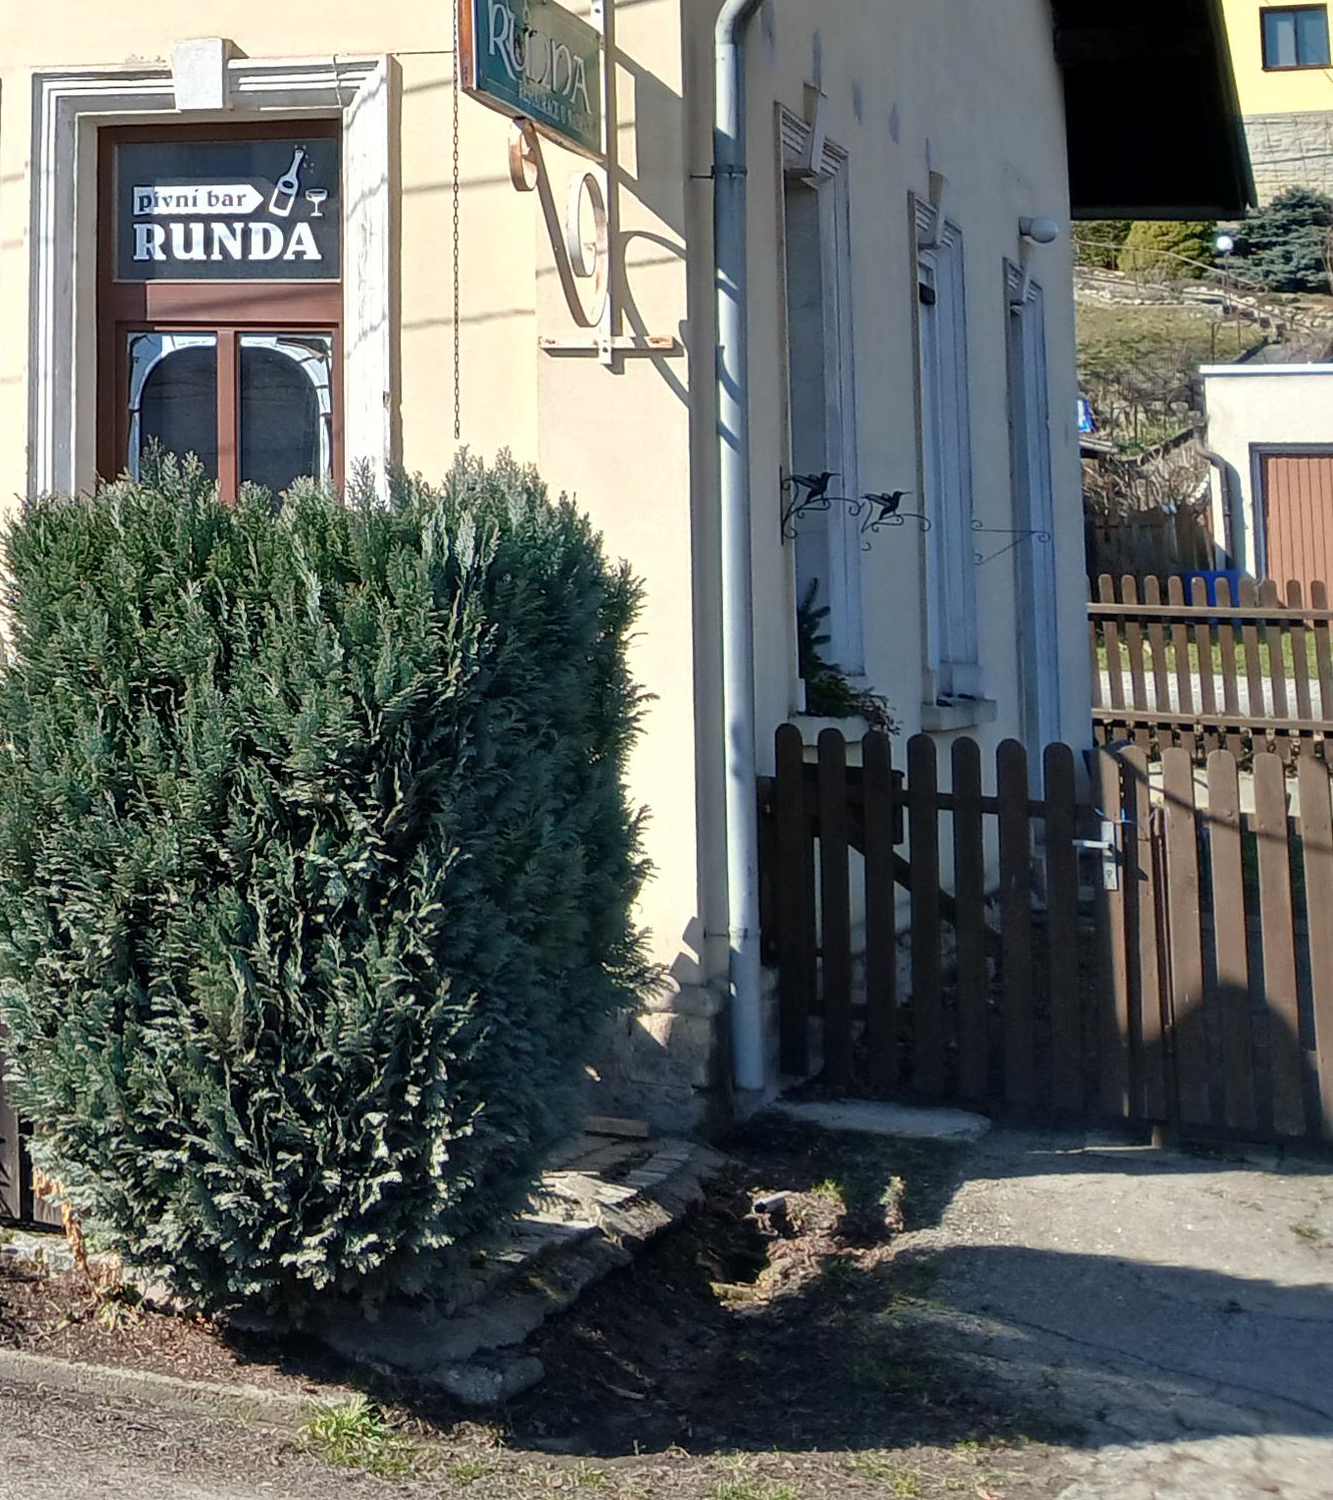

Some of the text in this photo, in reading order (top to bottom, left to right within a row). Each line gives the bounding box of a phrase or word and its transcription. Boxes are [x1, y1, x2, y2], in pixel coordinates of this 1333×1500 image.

[139, 188, 247, 210] pivní bar
[133, 222, 322, 260] RUNDA
